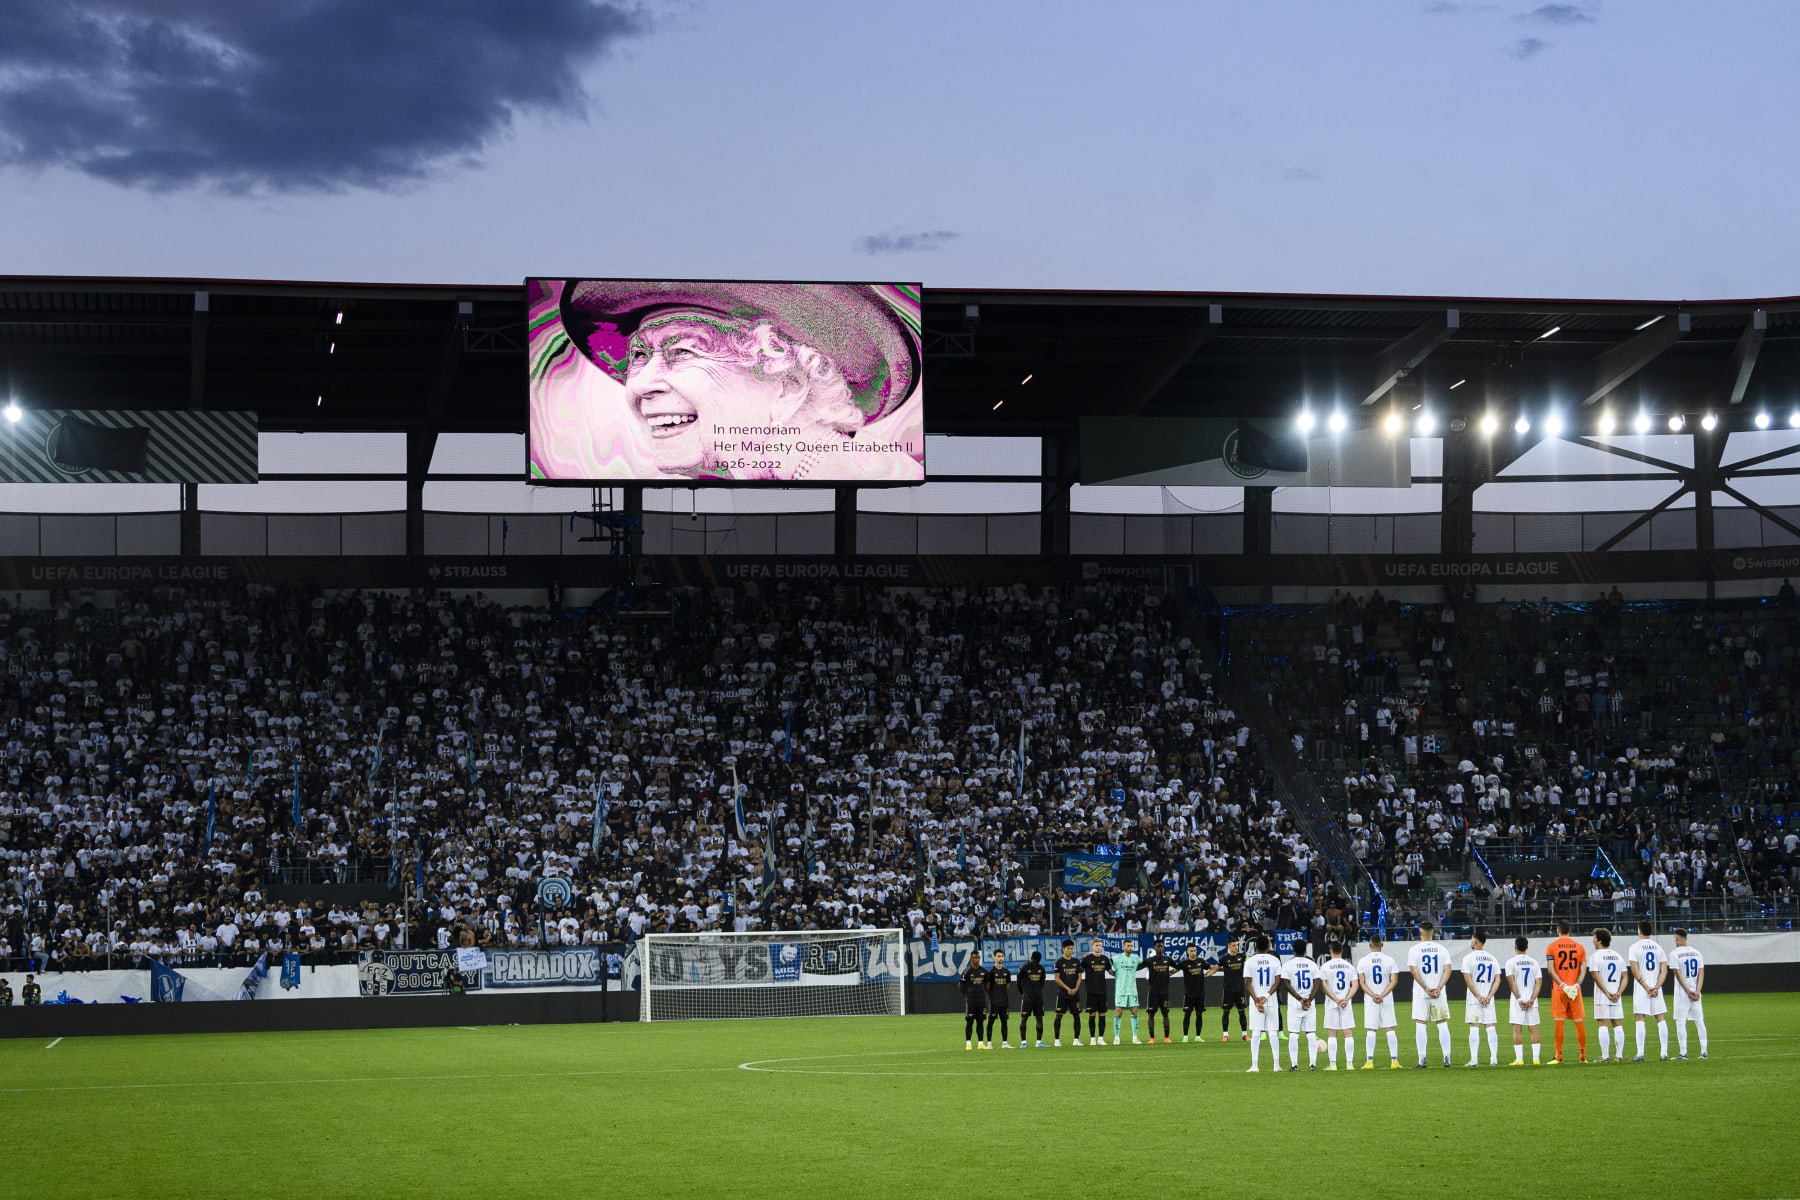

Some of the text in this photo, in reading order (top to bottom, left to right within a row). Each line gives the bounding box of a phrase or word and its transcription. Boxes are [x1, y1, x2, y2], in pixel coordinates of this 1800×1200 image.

[713, 424, 801, 434] In memoriam
[714, 441, 913, 455] Her Majesty Queen Elizabeth II
[713, 458, 782, 471] 1926-2022
[31, 566, 229, 580] UEFA EUROPA LEAGUE
[444, 566, 508, 577] STRAUSS
[726, 564, 910, 578] UEFA EUROPA LEAGUE
[1385, 562, 1559, 576] UEFA EUROPA LEAGUE
[1277, 931, 1303, 942] FREE
[387, 953, 460, 970] OUTCAS
[493, 952, 594, 981] PARADOX
[1422, 954, 1439, 974] 31
[1558, 950, 1578, 970] 25
[1645, 951, 1655, 971] 8
[1683, 958, 1698, 978] 19
[397, 970, 477, 988] SOCIY
[1256, 967, 1270, 987] 11
[1295, 969, 1311, 990] 15
[1336, 970, 1346, 990] 3
[1372, 965, 1383, 985] 6
[1476, 963, 1493, 983] 21
[1521, 967, 1530, 987] 7
[1607, 962, 1617, 983] 2
